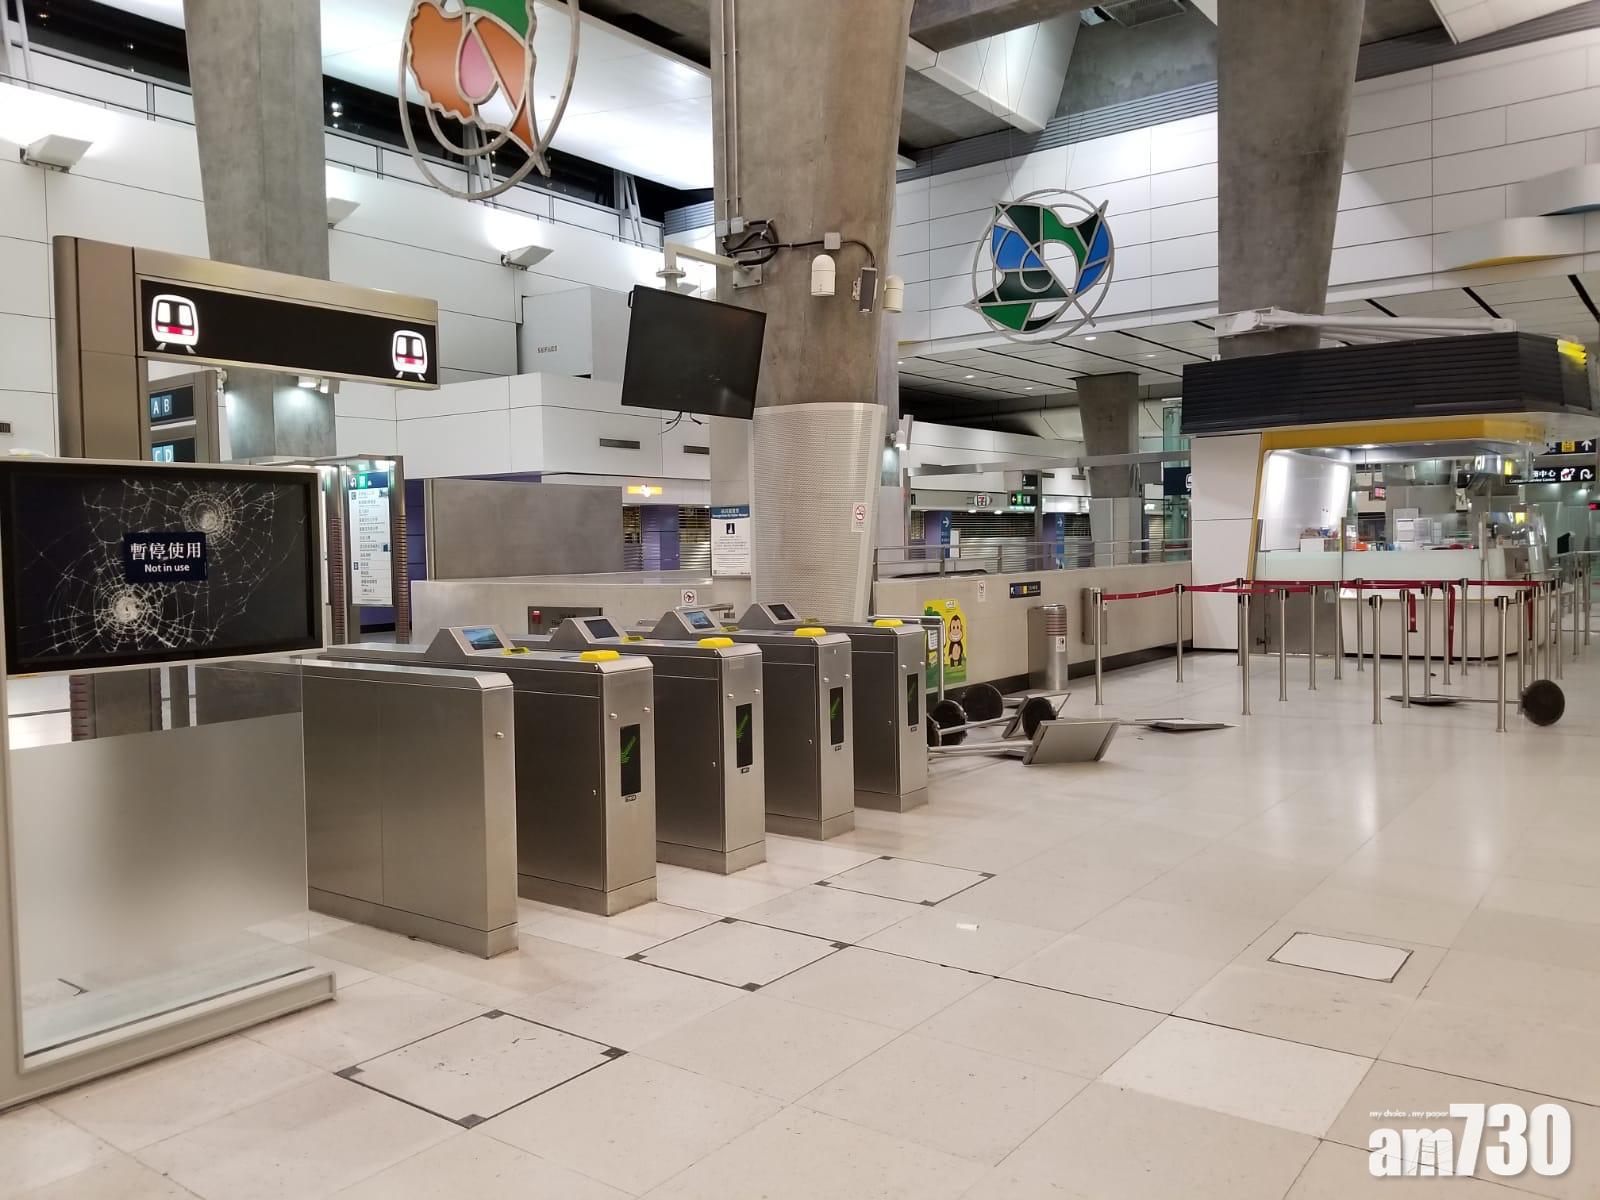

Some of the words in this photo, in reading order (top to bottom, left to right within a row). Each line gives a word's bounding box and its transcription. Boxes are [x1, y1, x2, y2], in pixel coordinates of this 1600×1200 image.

[153, 401, 160, 415] A
[164, 399, 170, 412] B
[165, 449, 172, 461] D
[130, 542, 201, 561] 暫停使用
[144, 563, 161, 573] Not
[163, 563, 172, 572] in
[174, 564, 190, 572] use
